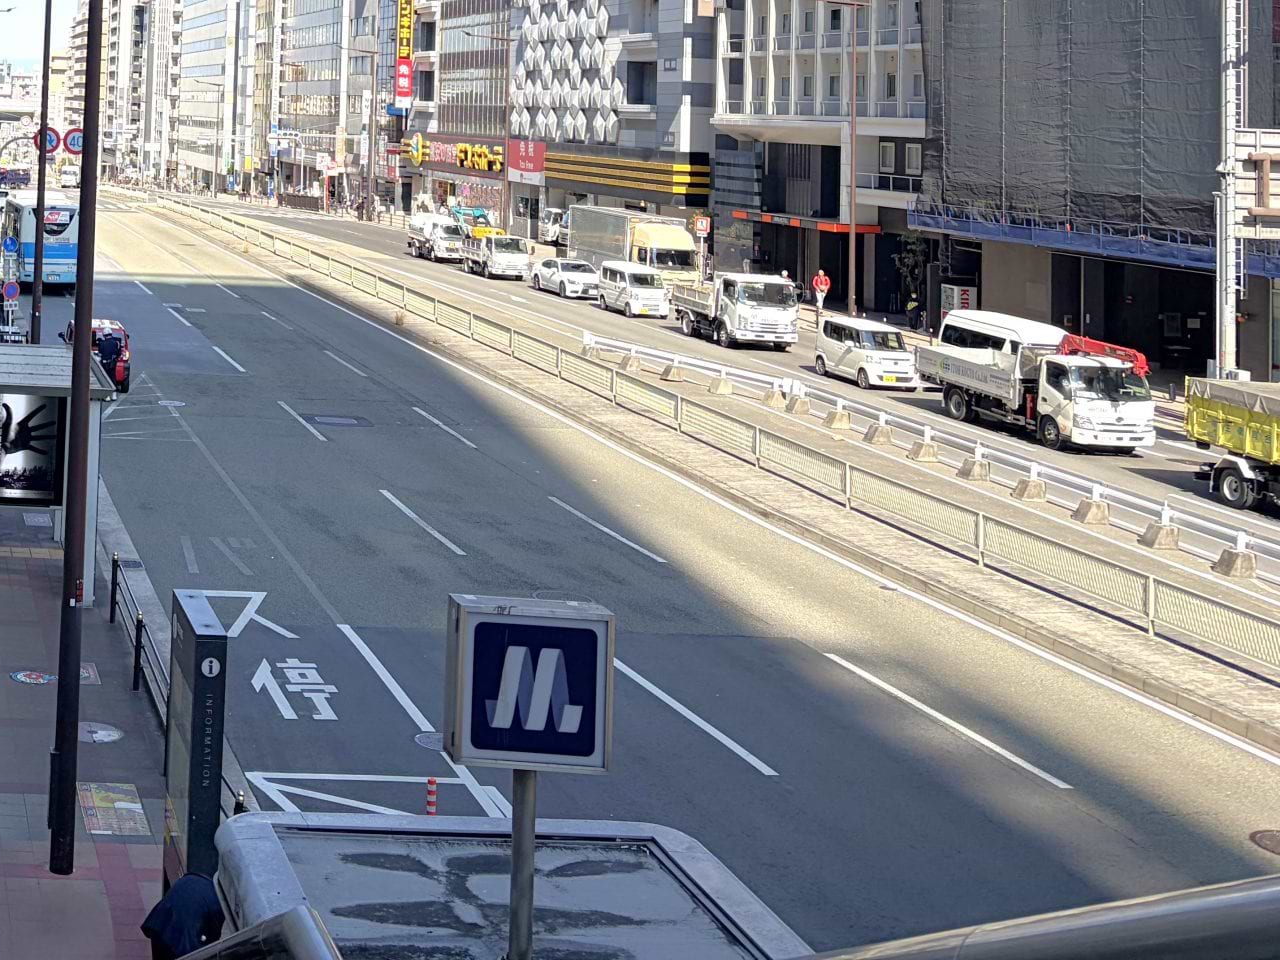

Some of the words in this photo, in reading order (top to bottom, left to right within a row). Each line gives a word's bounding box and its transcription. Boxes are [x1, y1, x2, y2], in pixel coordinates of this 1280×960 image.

[398, 64, 409, 88] 免税
[960, 289, 970, 310] KIR
[201, 693, 214, 788] INFORMATION
